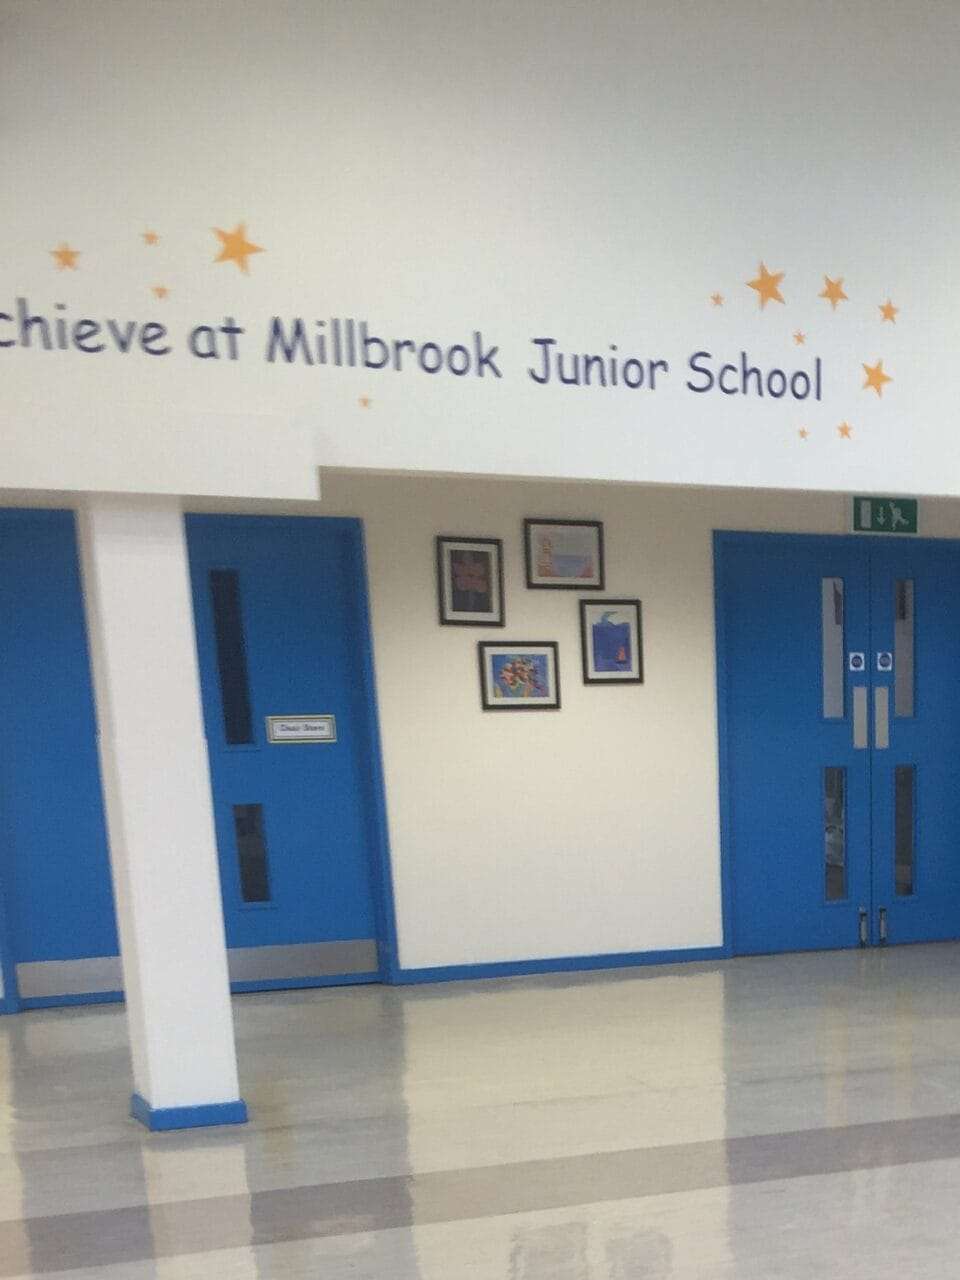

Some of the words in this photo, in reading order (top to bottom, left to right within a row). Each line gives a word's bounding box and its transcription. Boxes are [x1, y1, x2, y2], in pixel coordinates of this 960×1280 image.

[189, 316, 244, 361] at
[265, 315, 503, 379] Millbrook
[527, 337, 669, 391] Junior
[686, 350, 822, 402] School
